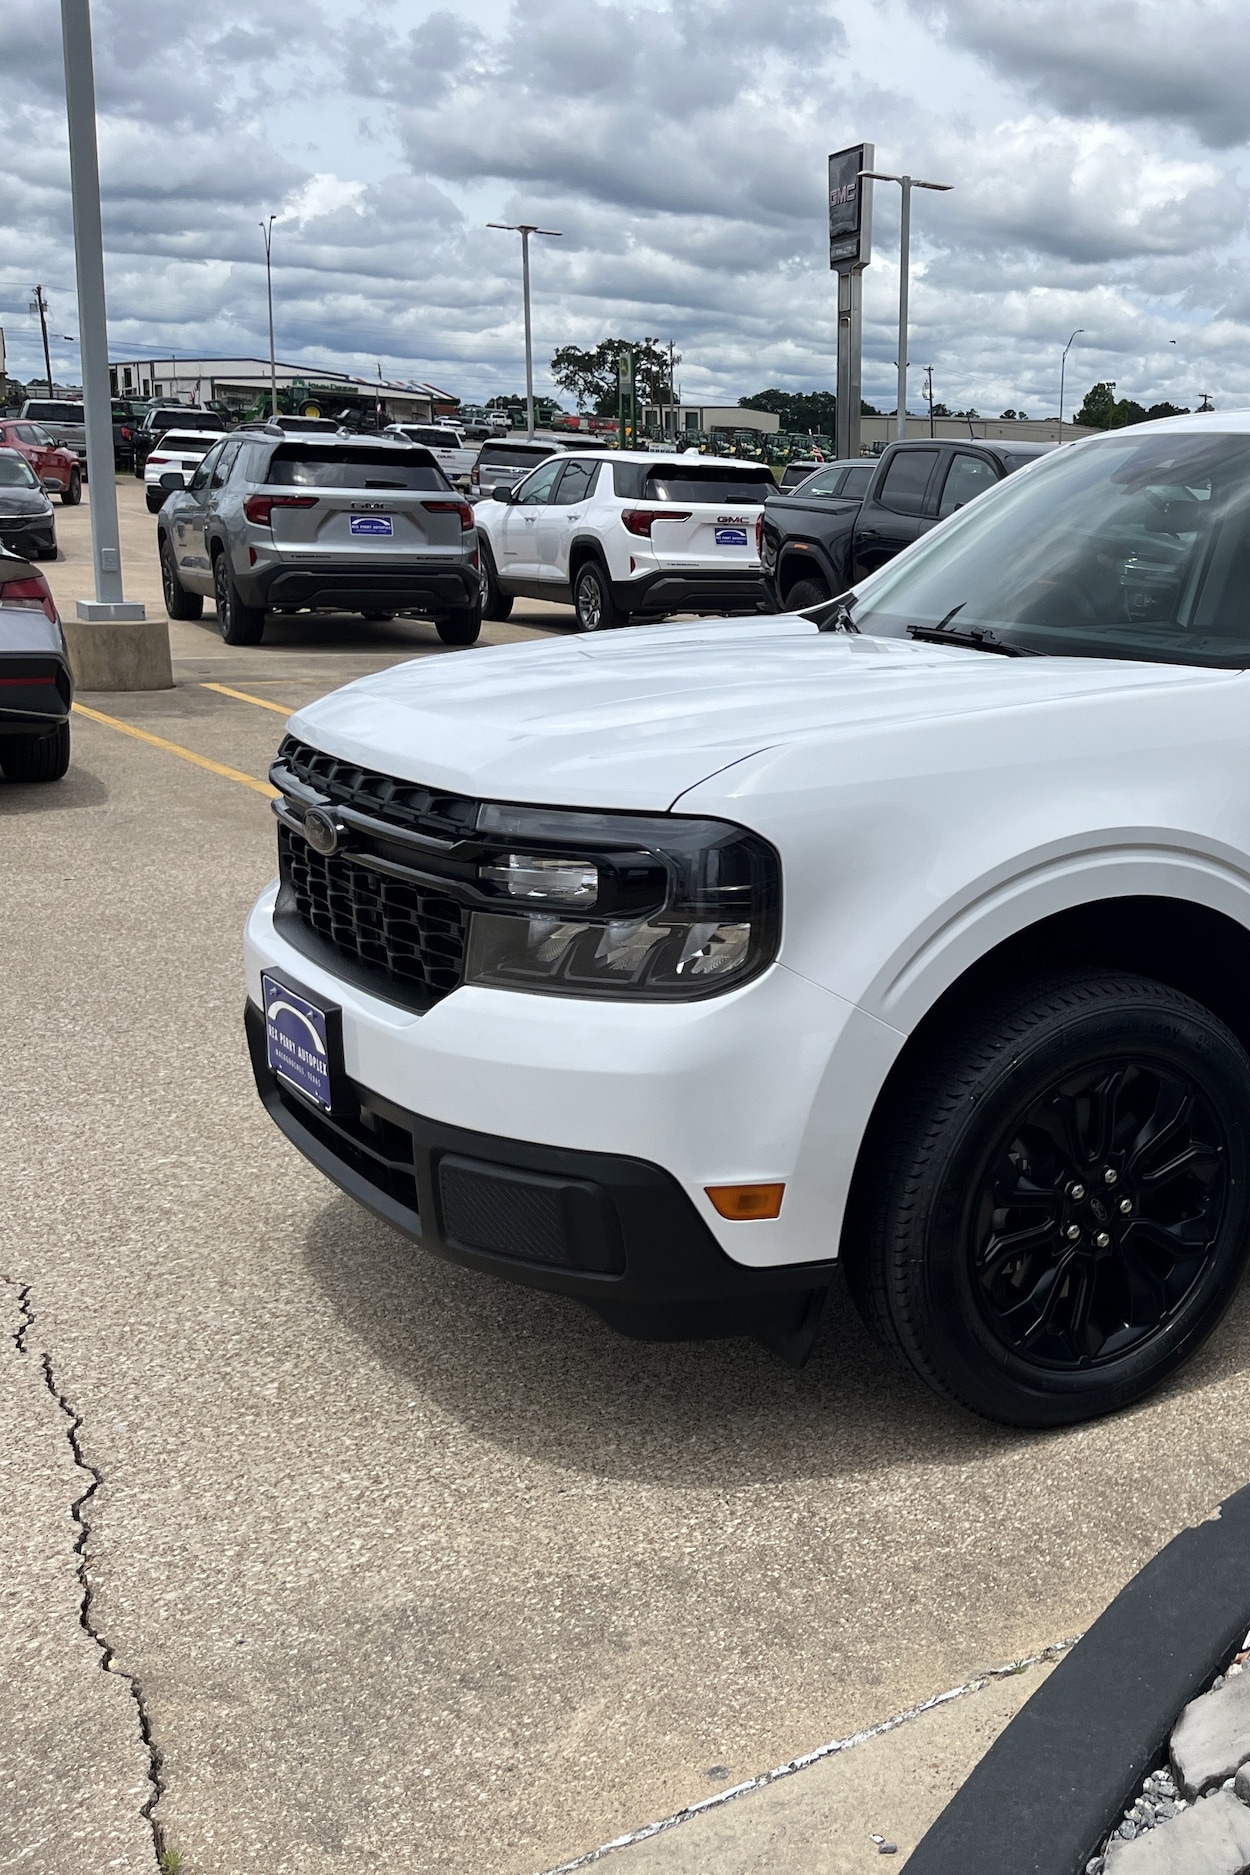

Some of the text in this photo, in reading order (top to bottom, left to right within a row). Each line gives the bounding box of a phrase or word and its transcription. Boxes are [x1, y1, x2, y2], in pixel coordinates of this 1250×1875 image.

[830, 183, 856, 207] GMC
[717, 516, 750, 524] GMC
[268, 1023, 328, 1077] REX PERRY AUTOPLEX
[307, 1070, 322, 1088] TEXAS
